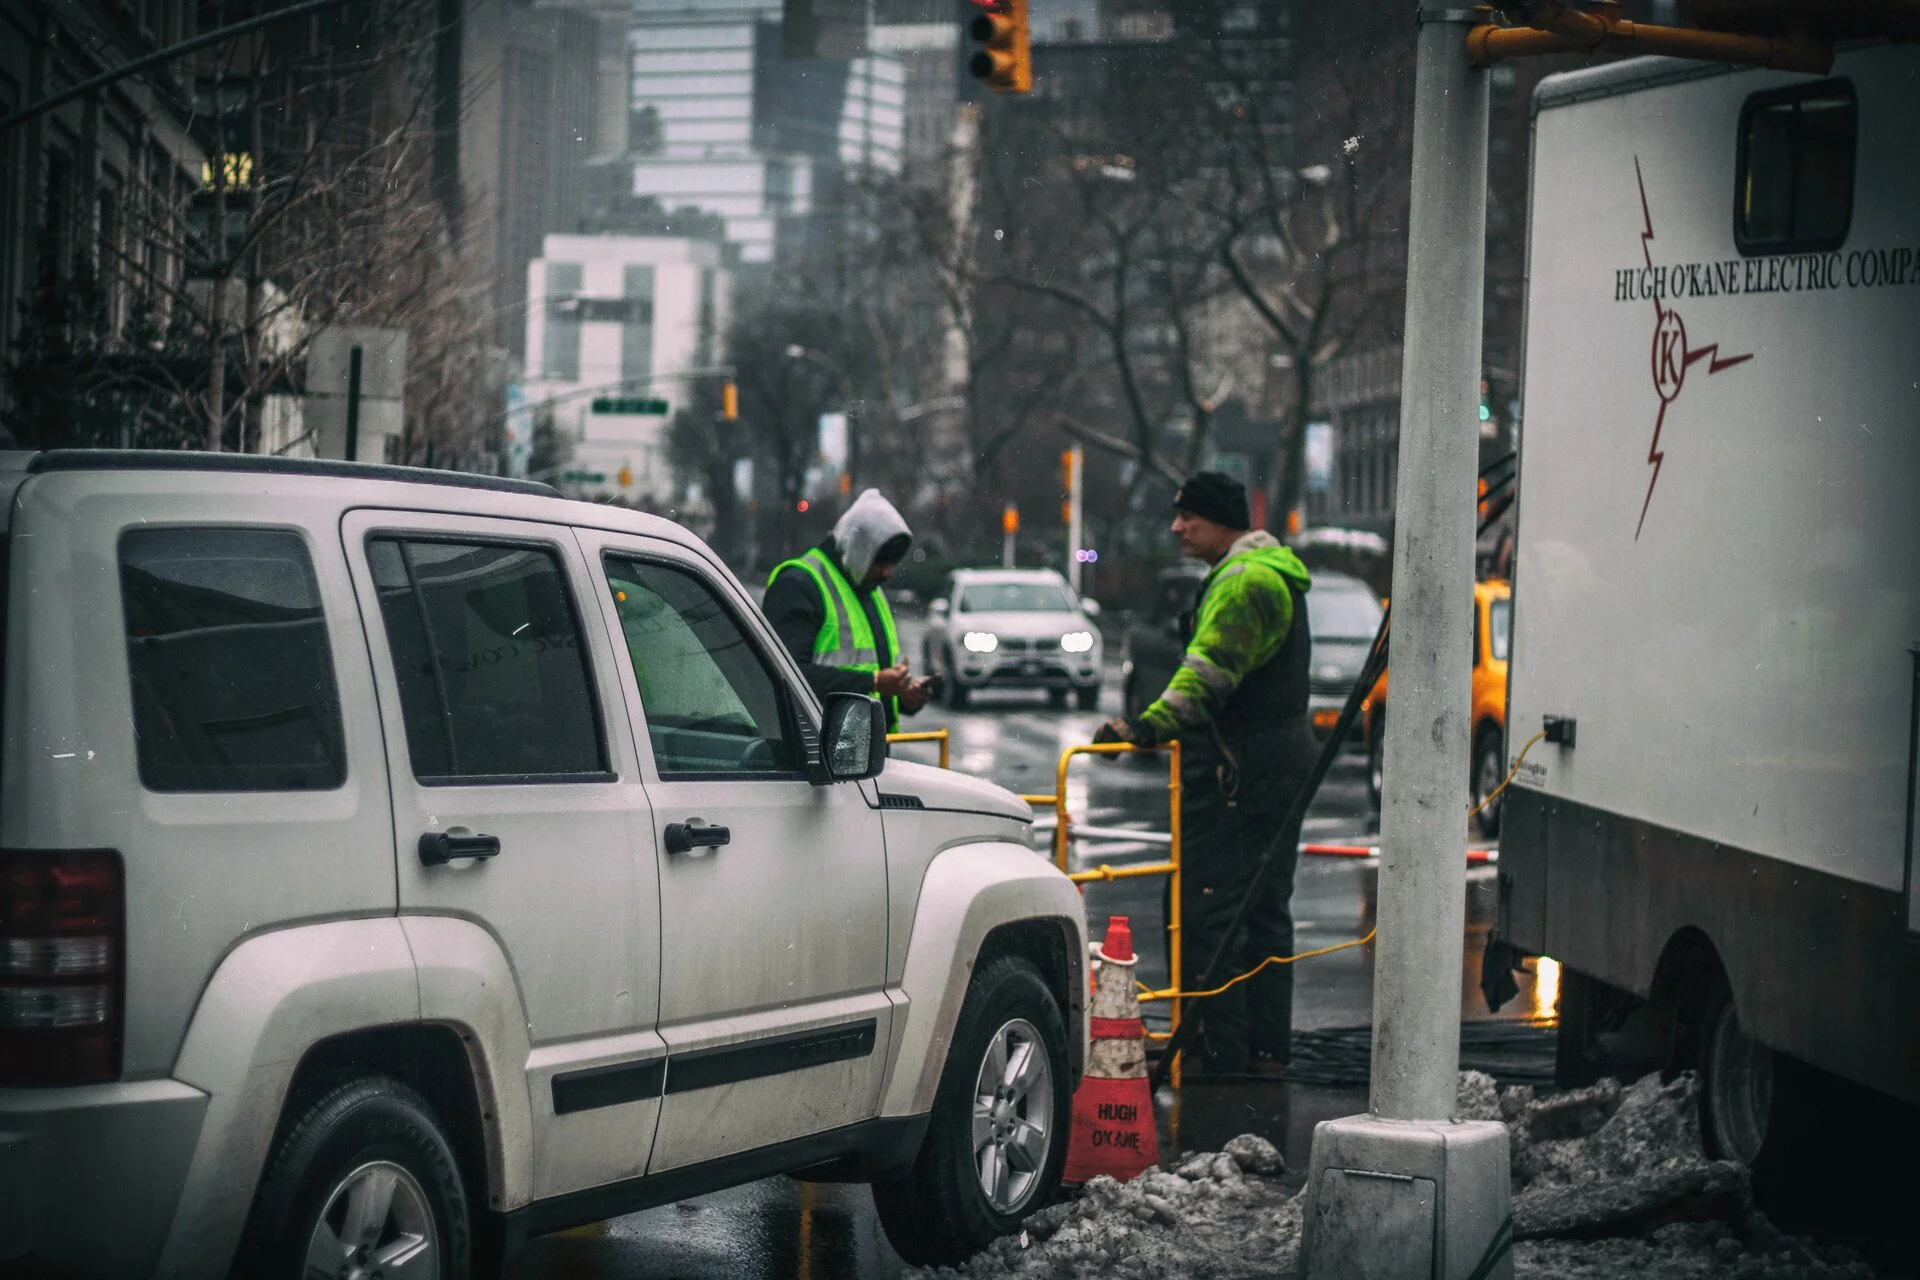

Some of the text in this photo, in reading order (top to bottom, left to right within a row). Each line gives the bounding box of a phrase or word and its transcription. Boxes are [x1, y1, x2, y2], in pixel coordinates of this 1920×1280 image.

[1615, 265, 1667, 301] HUGH
[1671, 259, 1740, 299] O'KANE
[1743, 252, 1843, 294] ELECTRIC
[1098, 1103, 1137, 1121] HUGH
